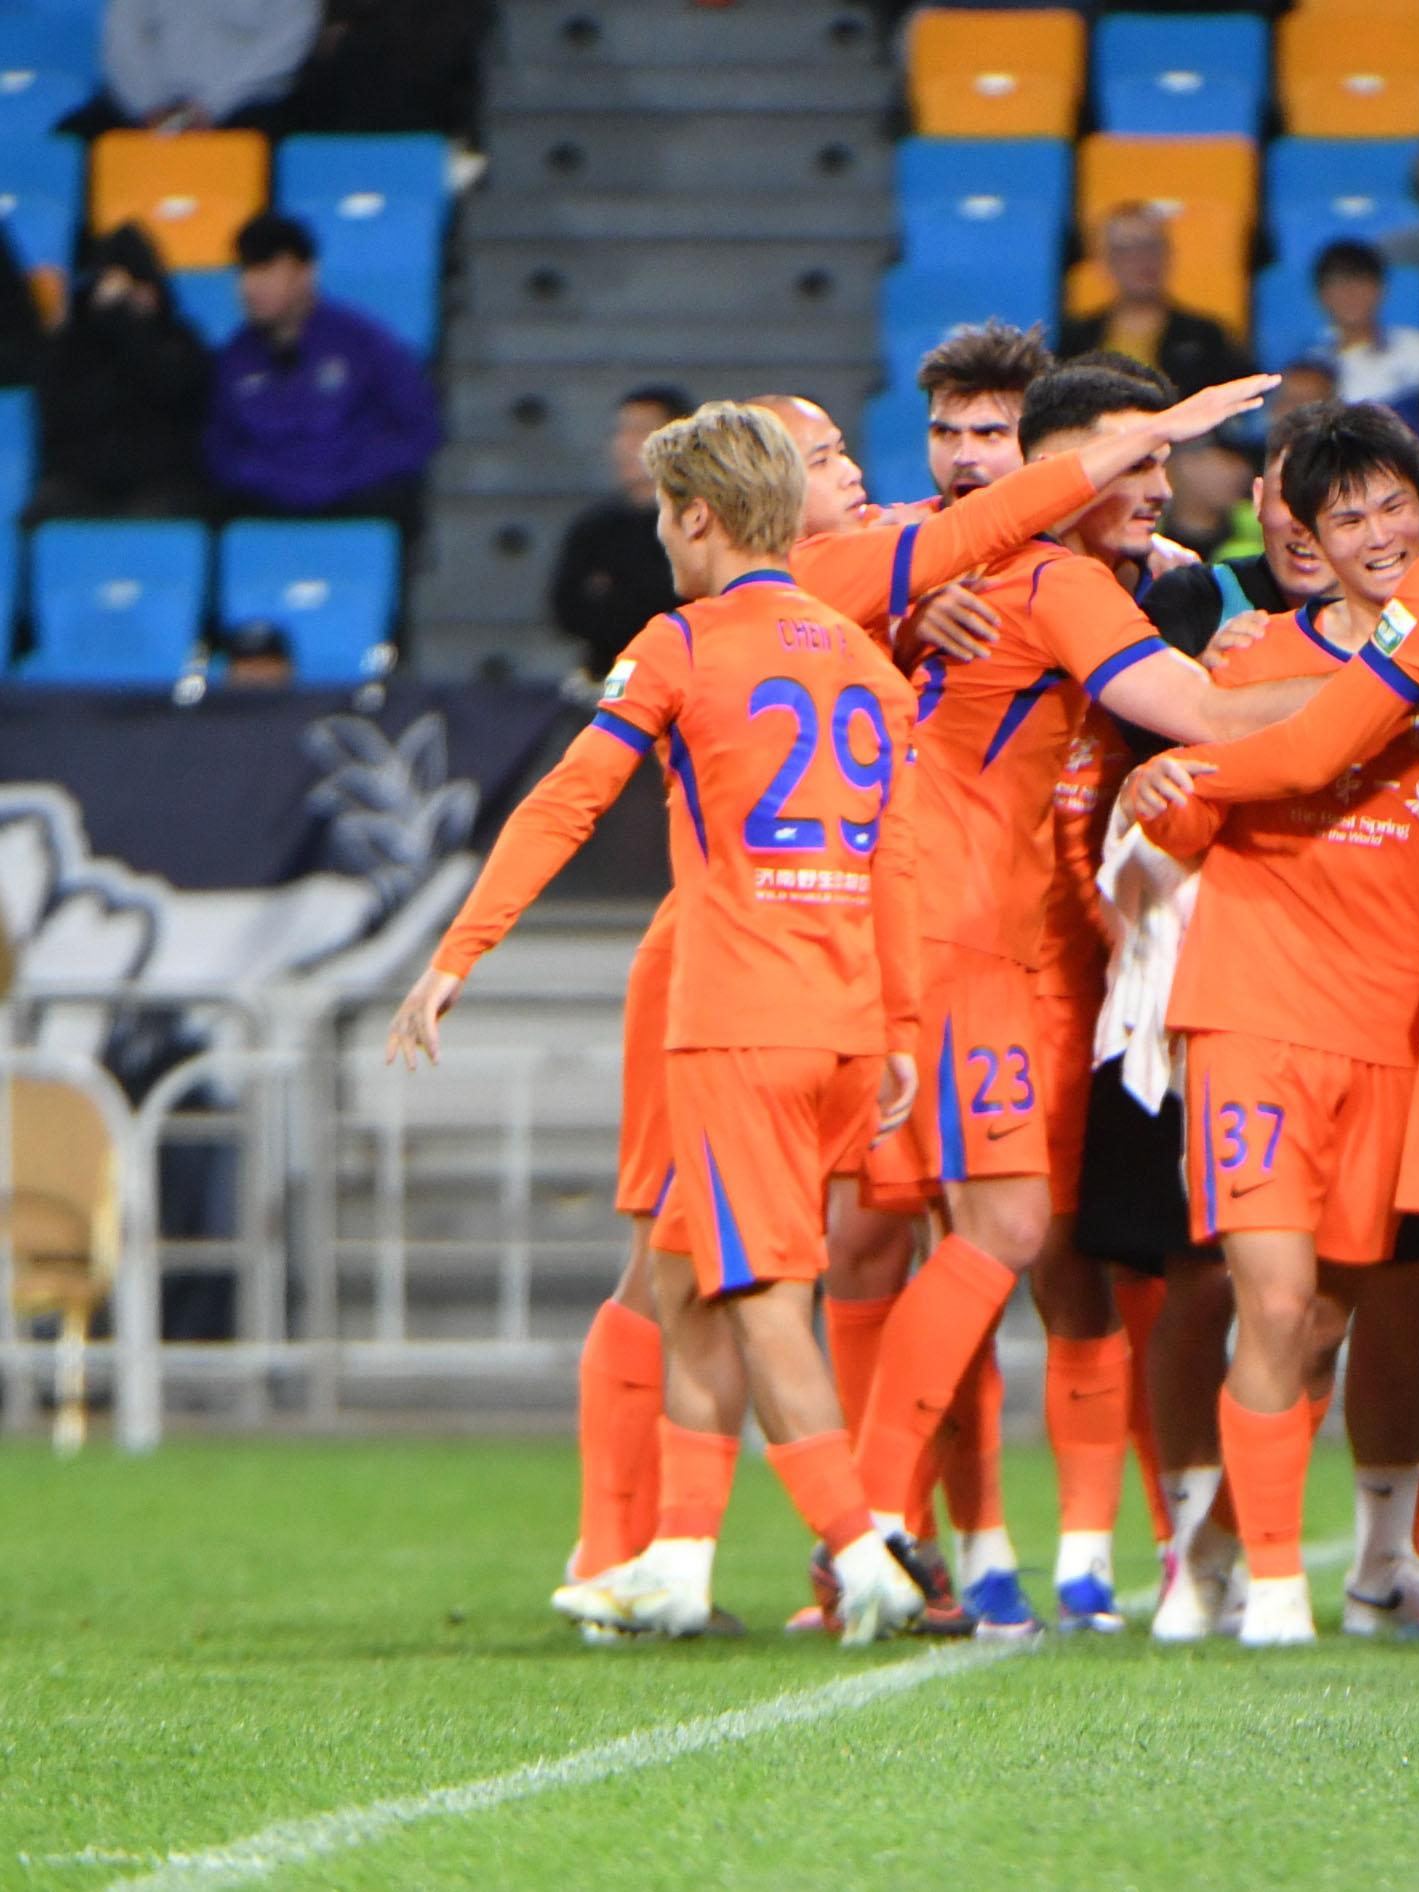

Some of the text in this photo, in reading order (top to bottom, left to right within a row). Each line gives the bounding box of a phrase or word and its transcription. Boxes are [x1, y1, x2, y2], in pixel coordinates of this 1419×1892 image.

[777, 618, 832, 652] CHEN
[744, 677, 894, 855] 29
[1328, 829, 1347, 843] the
[1349, 831, 1384, 847] World
[1359, 815, 1411, 842] Spring
[966, 1044, 1036, 1116] 23
[1218, 1101, 1286, 1171] 37
